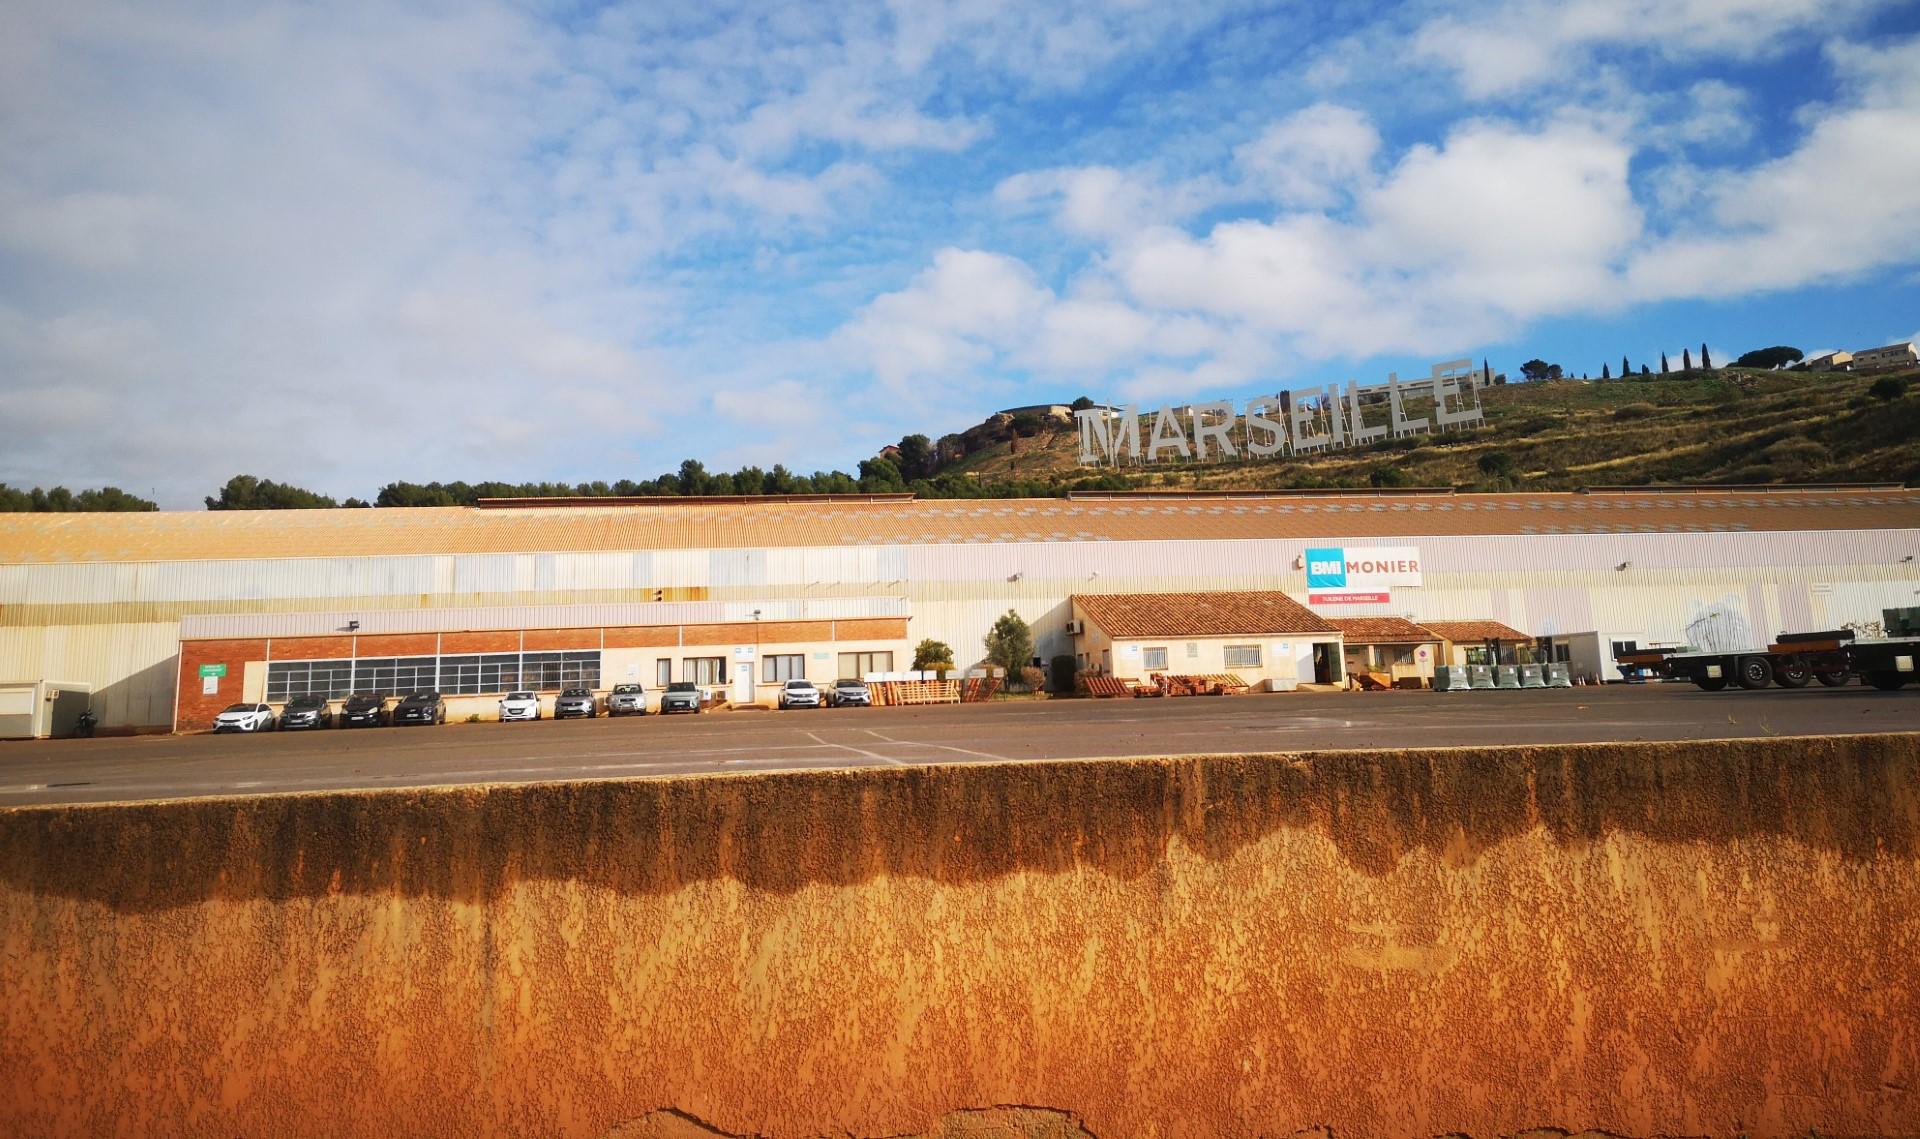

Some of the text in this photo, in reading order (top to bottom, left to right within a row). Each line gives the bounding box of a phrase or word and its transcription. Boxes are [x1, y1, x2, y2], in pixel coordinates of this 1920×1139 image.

[1074, 359, 1484, 463] MARSEILLE
[1311, 560, 1418, 575] BMI MONIER
